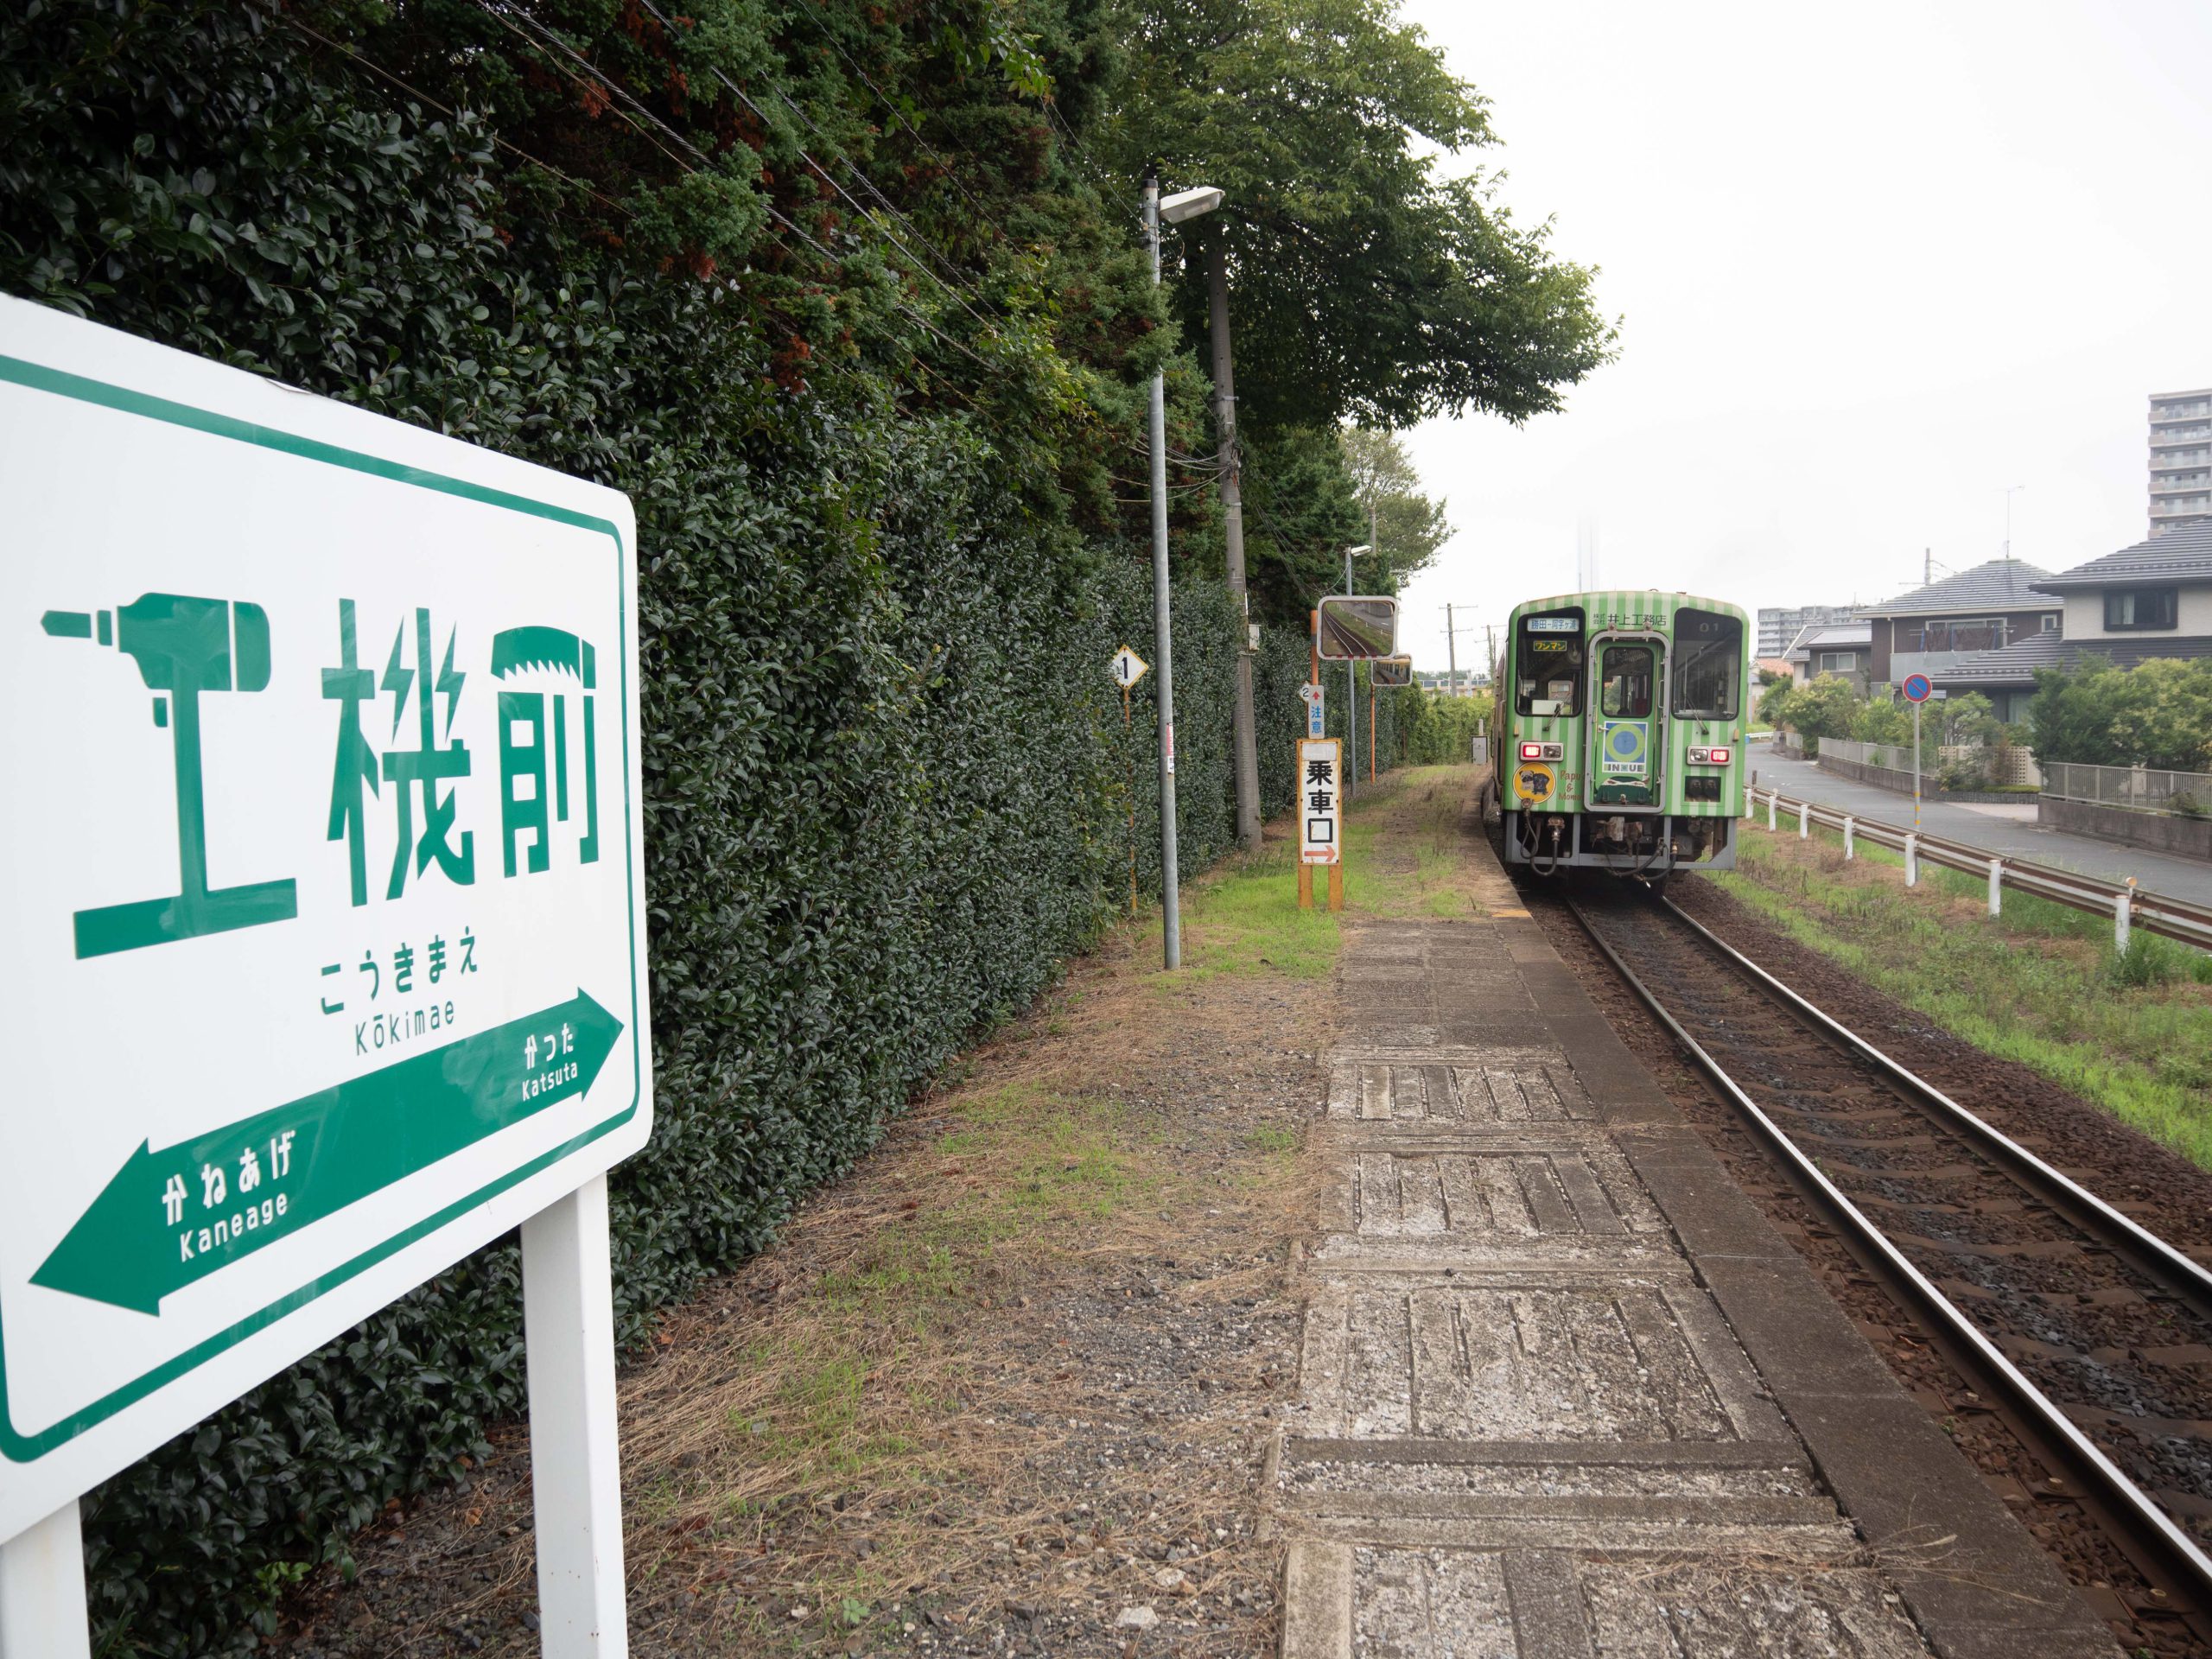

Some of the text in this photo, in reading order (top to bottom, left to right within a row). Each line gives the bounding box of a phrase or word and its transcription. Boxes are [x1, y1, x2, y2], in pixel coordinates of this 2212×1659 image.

[1608, 613, 1667, 626] 井上工務店
[1535, 641, 1566, 651] ワンマン
[1122, 657, 1128, 679] 1
[1302, 688, 1309, 697] 2
[1311, 705, 1322, 734] 注意
[41, 592, 600, 961] 工機前
[1566, 783, 1573, 793] &
[1306, 760, 1334, 843] 乗車口
[321, 925, 478, 1015] こうきまえ
[355, 1000, 455, 1056] Kōkimae
[522, 1062, 579, 1102] Katsuta
[162, 1130, 296, 1226] かねあげ
[180, 1192, 288, 1262] Kaneage
